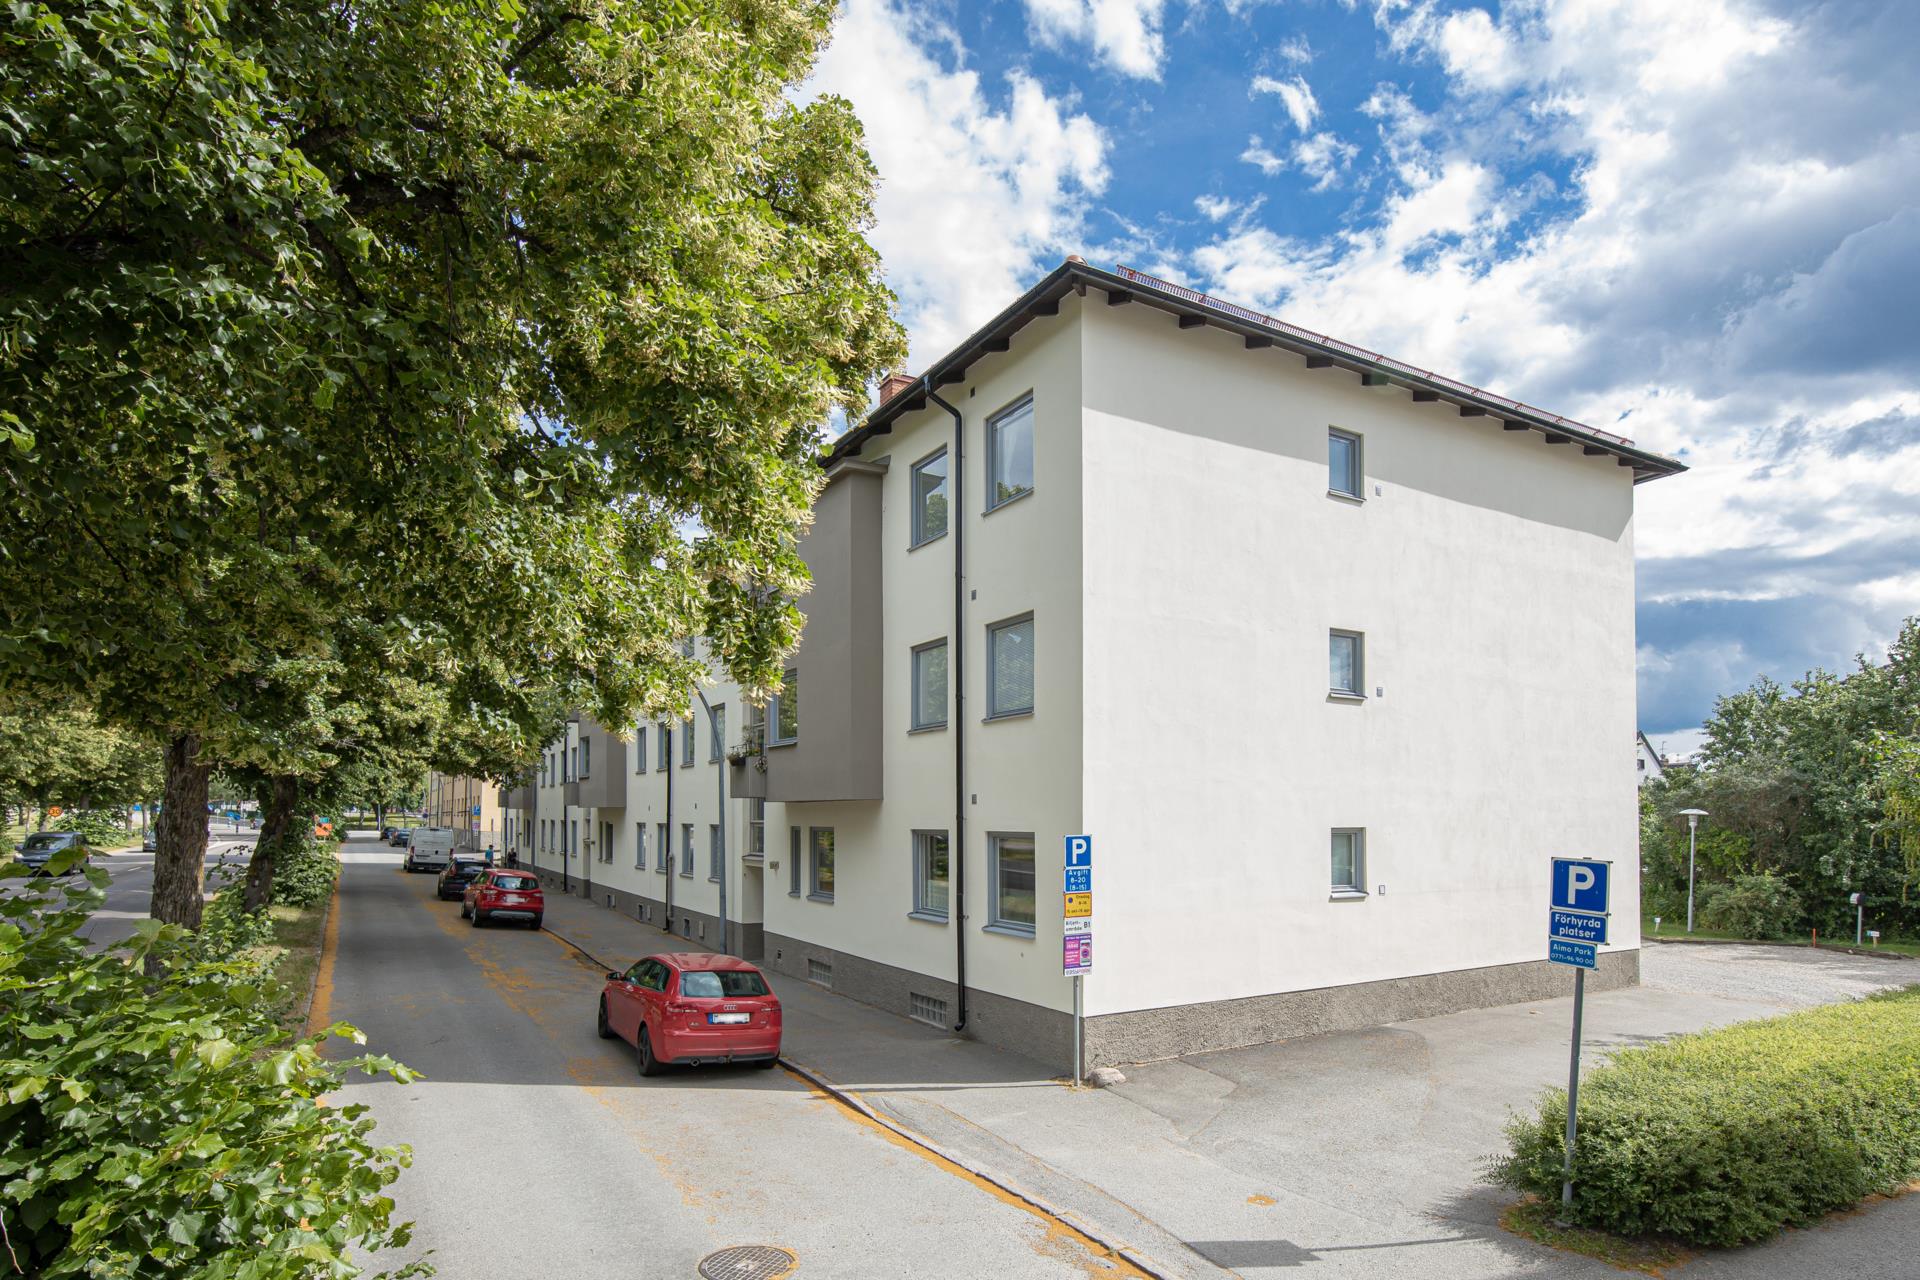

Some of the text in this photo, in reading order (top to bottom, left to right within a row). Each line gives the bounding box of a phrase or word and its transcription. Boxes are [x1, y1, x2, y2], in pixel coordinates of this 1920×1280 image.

[1072, 839, 1087, 864] P
[1568, 865, 1595, 905] P
[1555, 913, 1601, 928] Förhyrda
[1559, 926, 1596, 939] platser
[1553, 943, 1592, 956] Aimo Park
[1550, 953, 1574, 961] 0771-96
